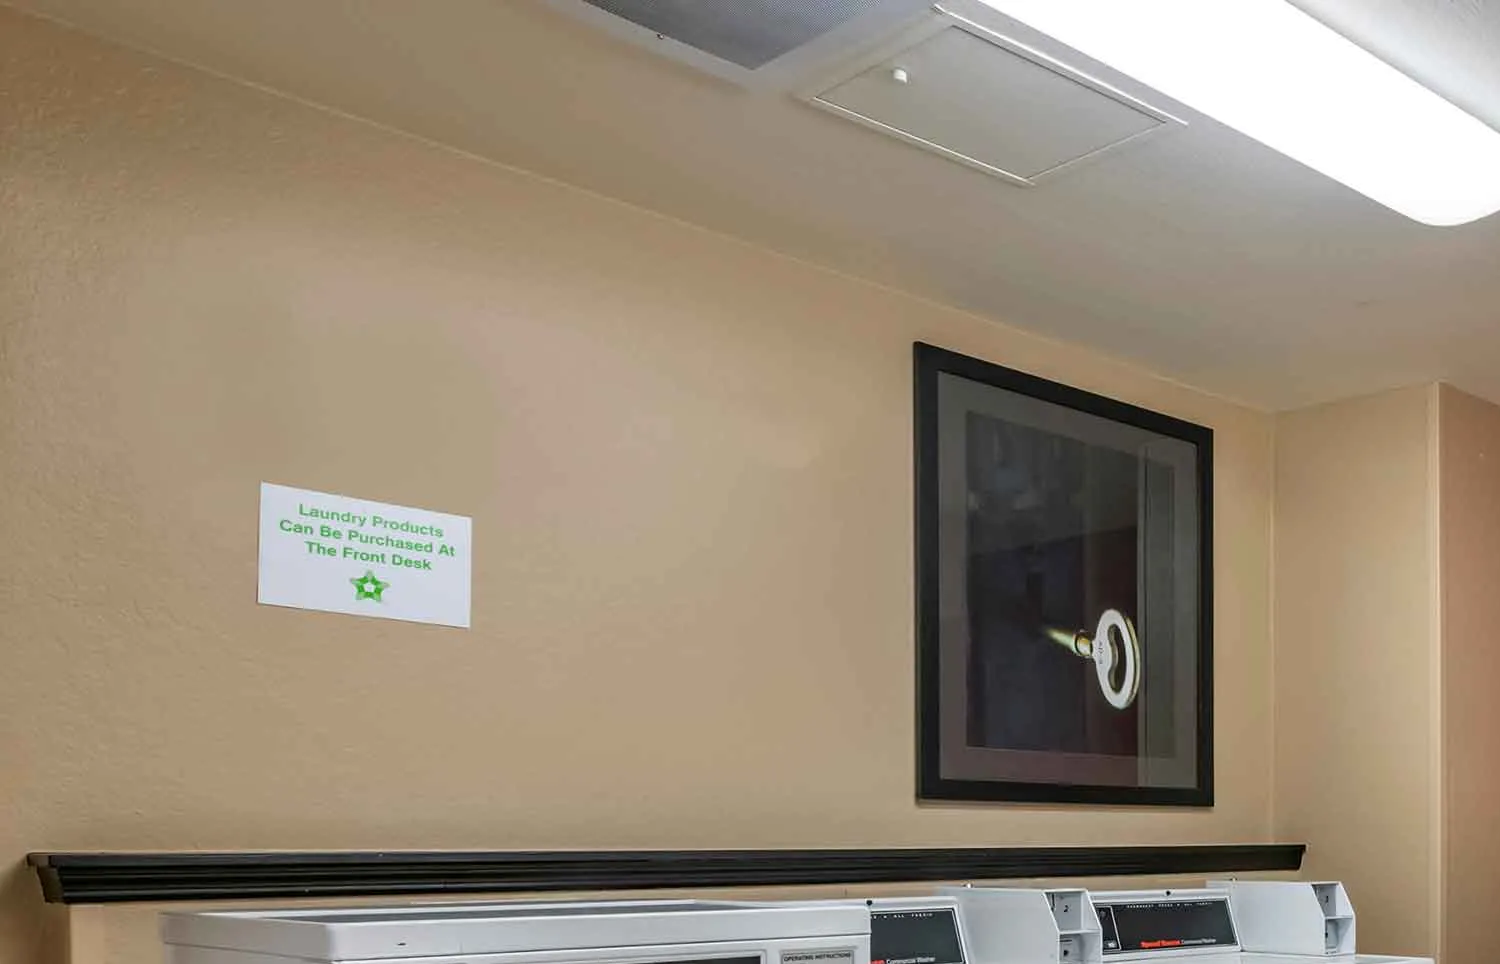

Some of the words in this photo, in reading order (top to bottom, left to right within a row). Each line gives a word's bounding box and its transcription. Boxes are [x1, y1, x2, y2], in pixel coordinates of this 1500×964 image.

[298, 503, 366, 527] Laundry
[372, 515, 444, 537] Products
[279, 519, 314, 536] Can
[320, 525, 343, 540] Be
[348, 529, 433, 553] Purchased
[438, 543, 456, 557] At
[304, 540, 337, 557] The
[342, 547, 387, 564] Front
[391, 554, 432, 570] Desk
